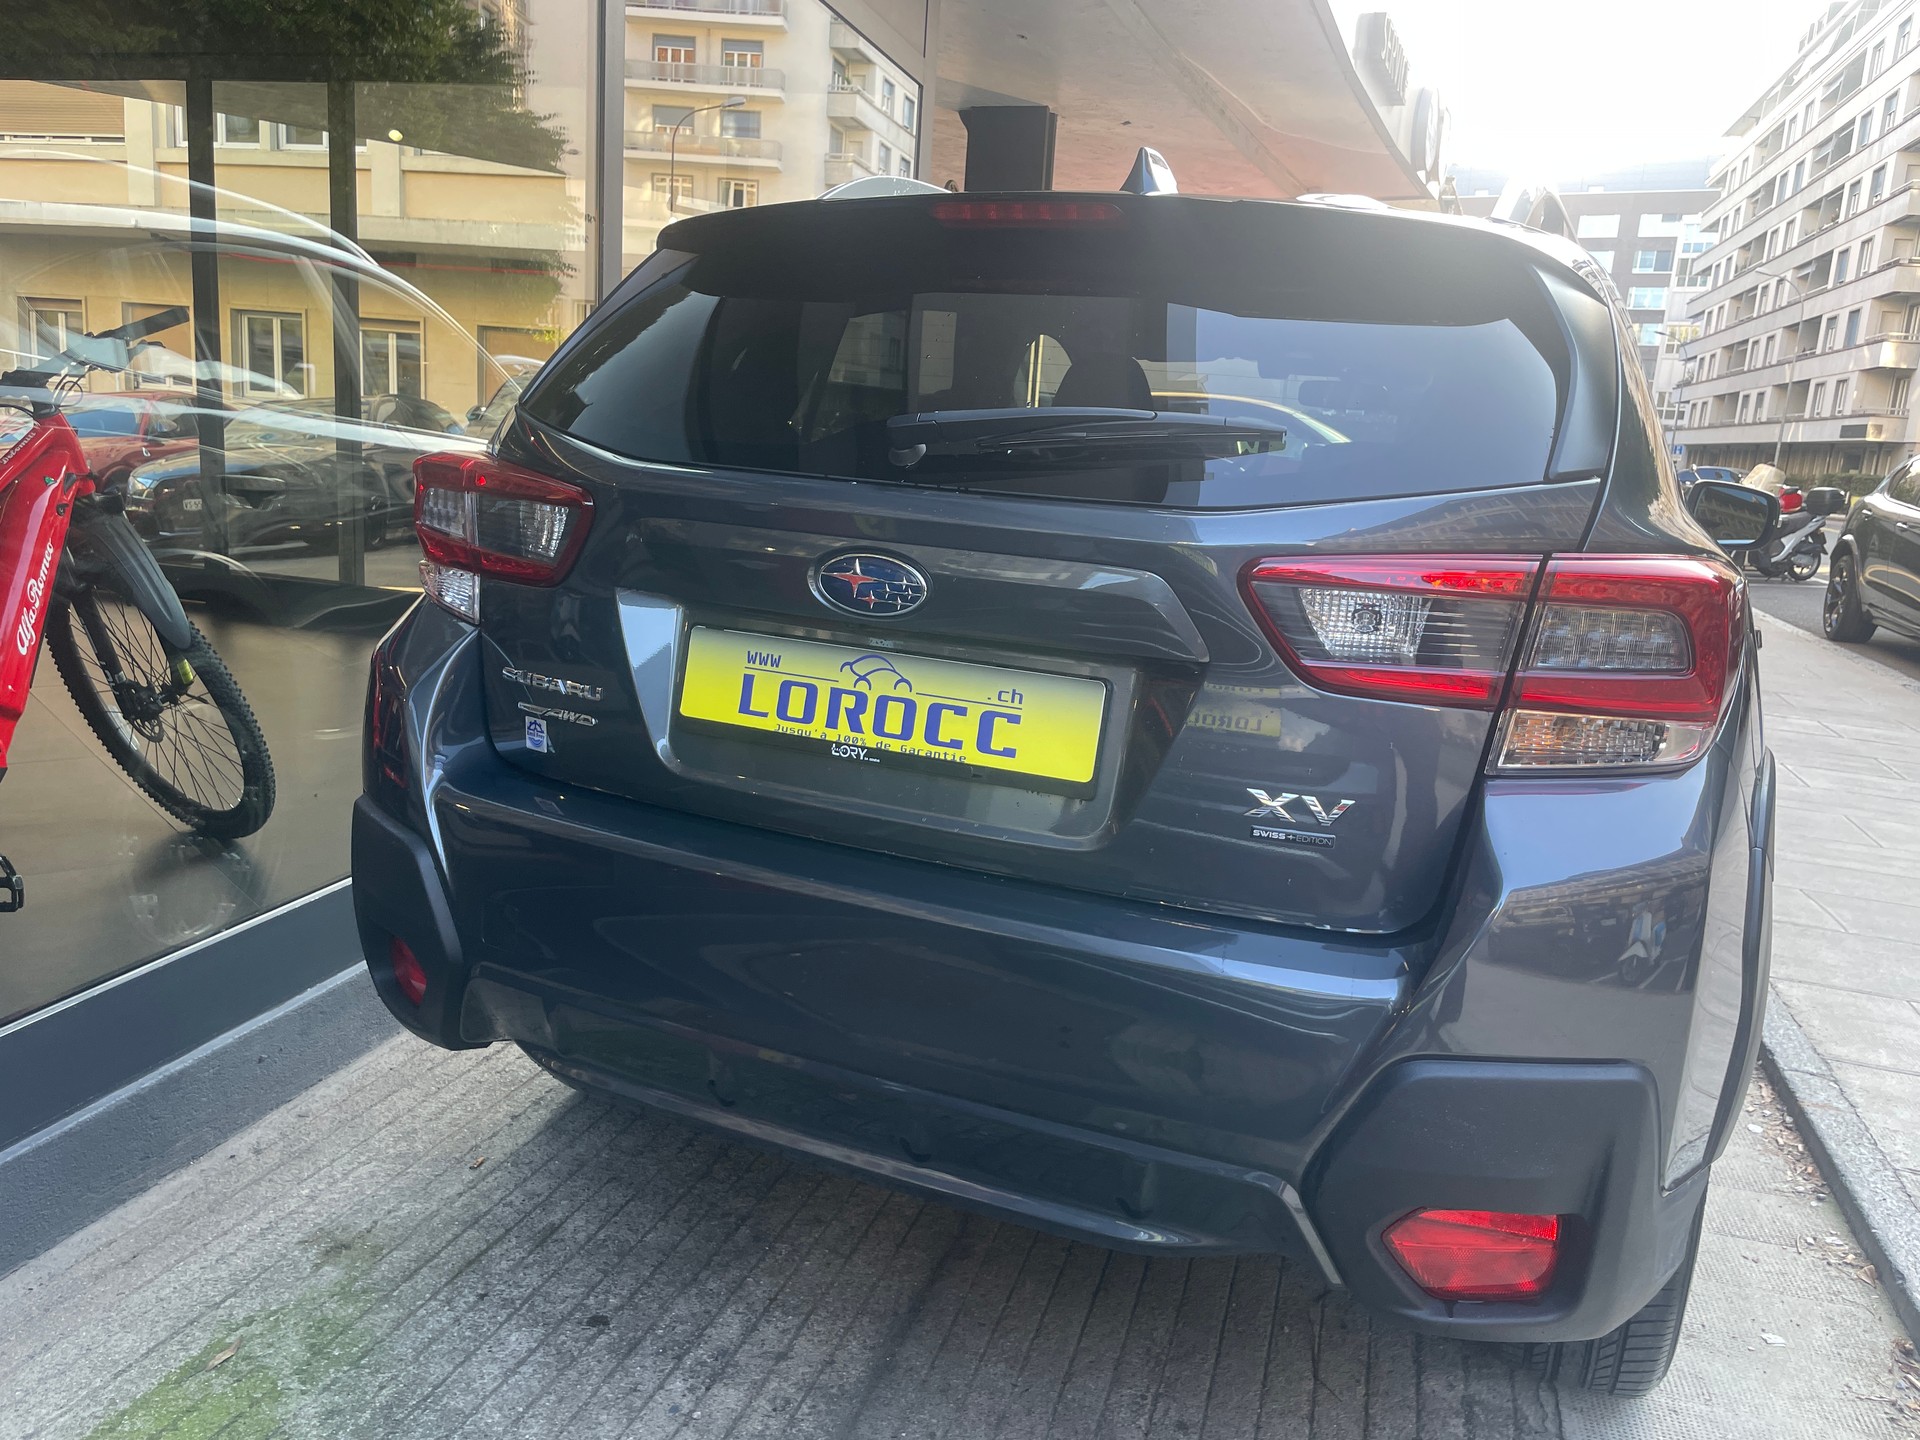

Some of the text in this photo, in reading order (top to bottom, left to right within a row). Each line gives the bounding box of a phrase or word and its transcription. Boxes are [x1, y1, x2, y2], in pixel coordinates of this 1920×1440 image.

[16, 538, 54, 656] Alfa Romeo
[738, 673, 1022, 758] LOROCC
[875, 740, 891, 751] de
[900, 744, 967, 763] Garantie
[1244, 788, 1356, 826] XV
[1252, 829, 1286, 841] SWISS
[1296, 834, 1333, 846] EDITION
